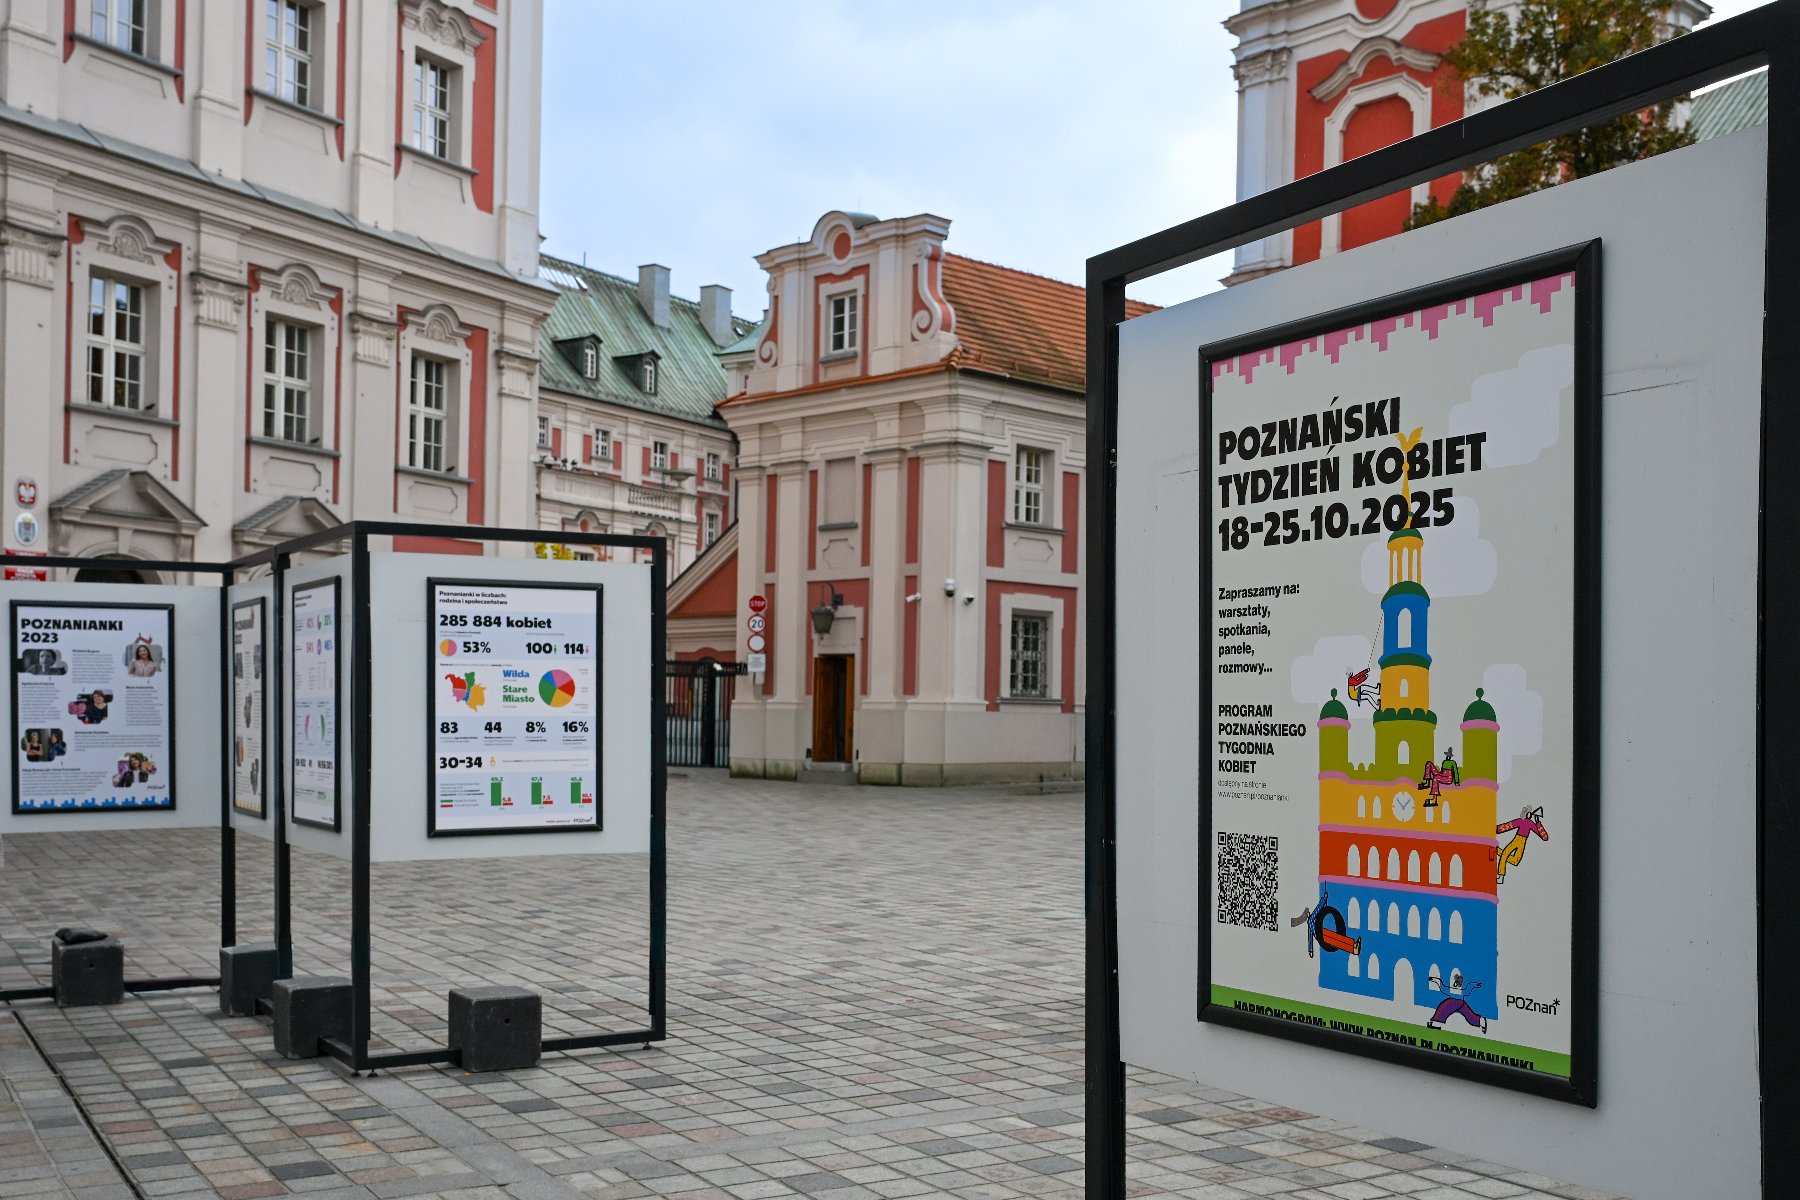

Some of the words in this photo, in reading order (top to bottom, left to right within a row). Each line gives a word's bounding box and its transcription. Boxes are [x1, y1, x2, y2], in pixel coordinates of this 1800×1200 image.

[1219, 396, 1400, 465] POZNAŃSKI
[1218, 445, 1340, 509] TYDZIEŃ
[1352, 432, 1487, 489] KOBIET
[1218, 487, 1455, 552] 18-25.10.2025
[1218, 585, 1282, 602] Zapraszamy
[1283, 584, 1300, 595] na:
[1218, 604, 1271, 618] warsztaty,
[21, 618, 123, 631] POZNANIANKI
[439, 615, 468, 627] 285
[472, 615, 502, 628] 884
[506, 616, 552, 629] kobiet
[751, 619, 764, 629] 20
[1218, 622, 1271, 639] spotkania,
[21, 632, 59, 643] 2023
[462, 641, 491, 653] 53%
[526, 642, 552, 654] 100
[564, 643, 584, 654] 114
[1218, 642, 1255, 657] panele,
[502, 669, 530, 678] Wilda
[1218, 663, 1273, 675] rozmowy...
[502, 685, 528, 693] Stare
[502, 694, 535, 703] Miasto
[1218, 704, 1273, 717] PROGRAM
[440, 721, 459, 733] 83
[484, 722, 502, 733] 44
[525, 721, 547, 733] 8%
[562, 721, 589, 733] 16%
[1218, 721, 1307, 737] POZNAŃSKIEGO
[1218, 741, 1275, 756] TYGODNIA
[439, 756, 483, 769] 30-34
[1218, 760, 1257, 774] KOBIET
